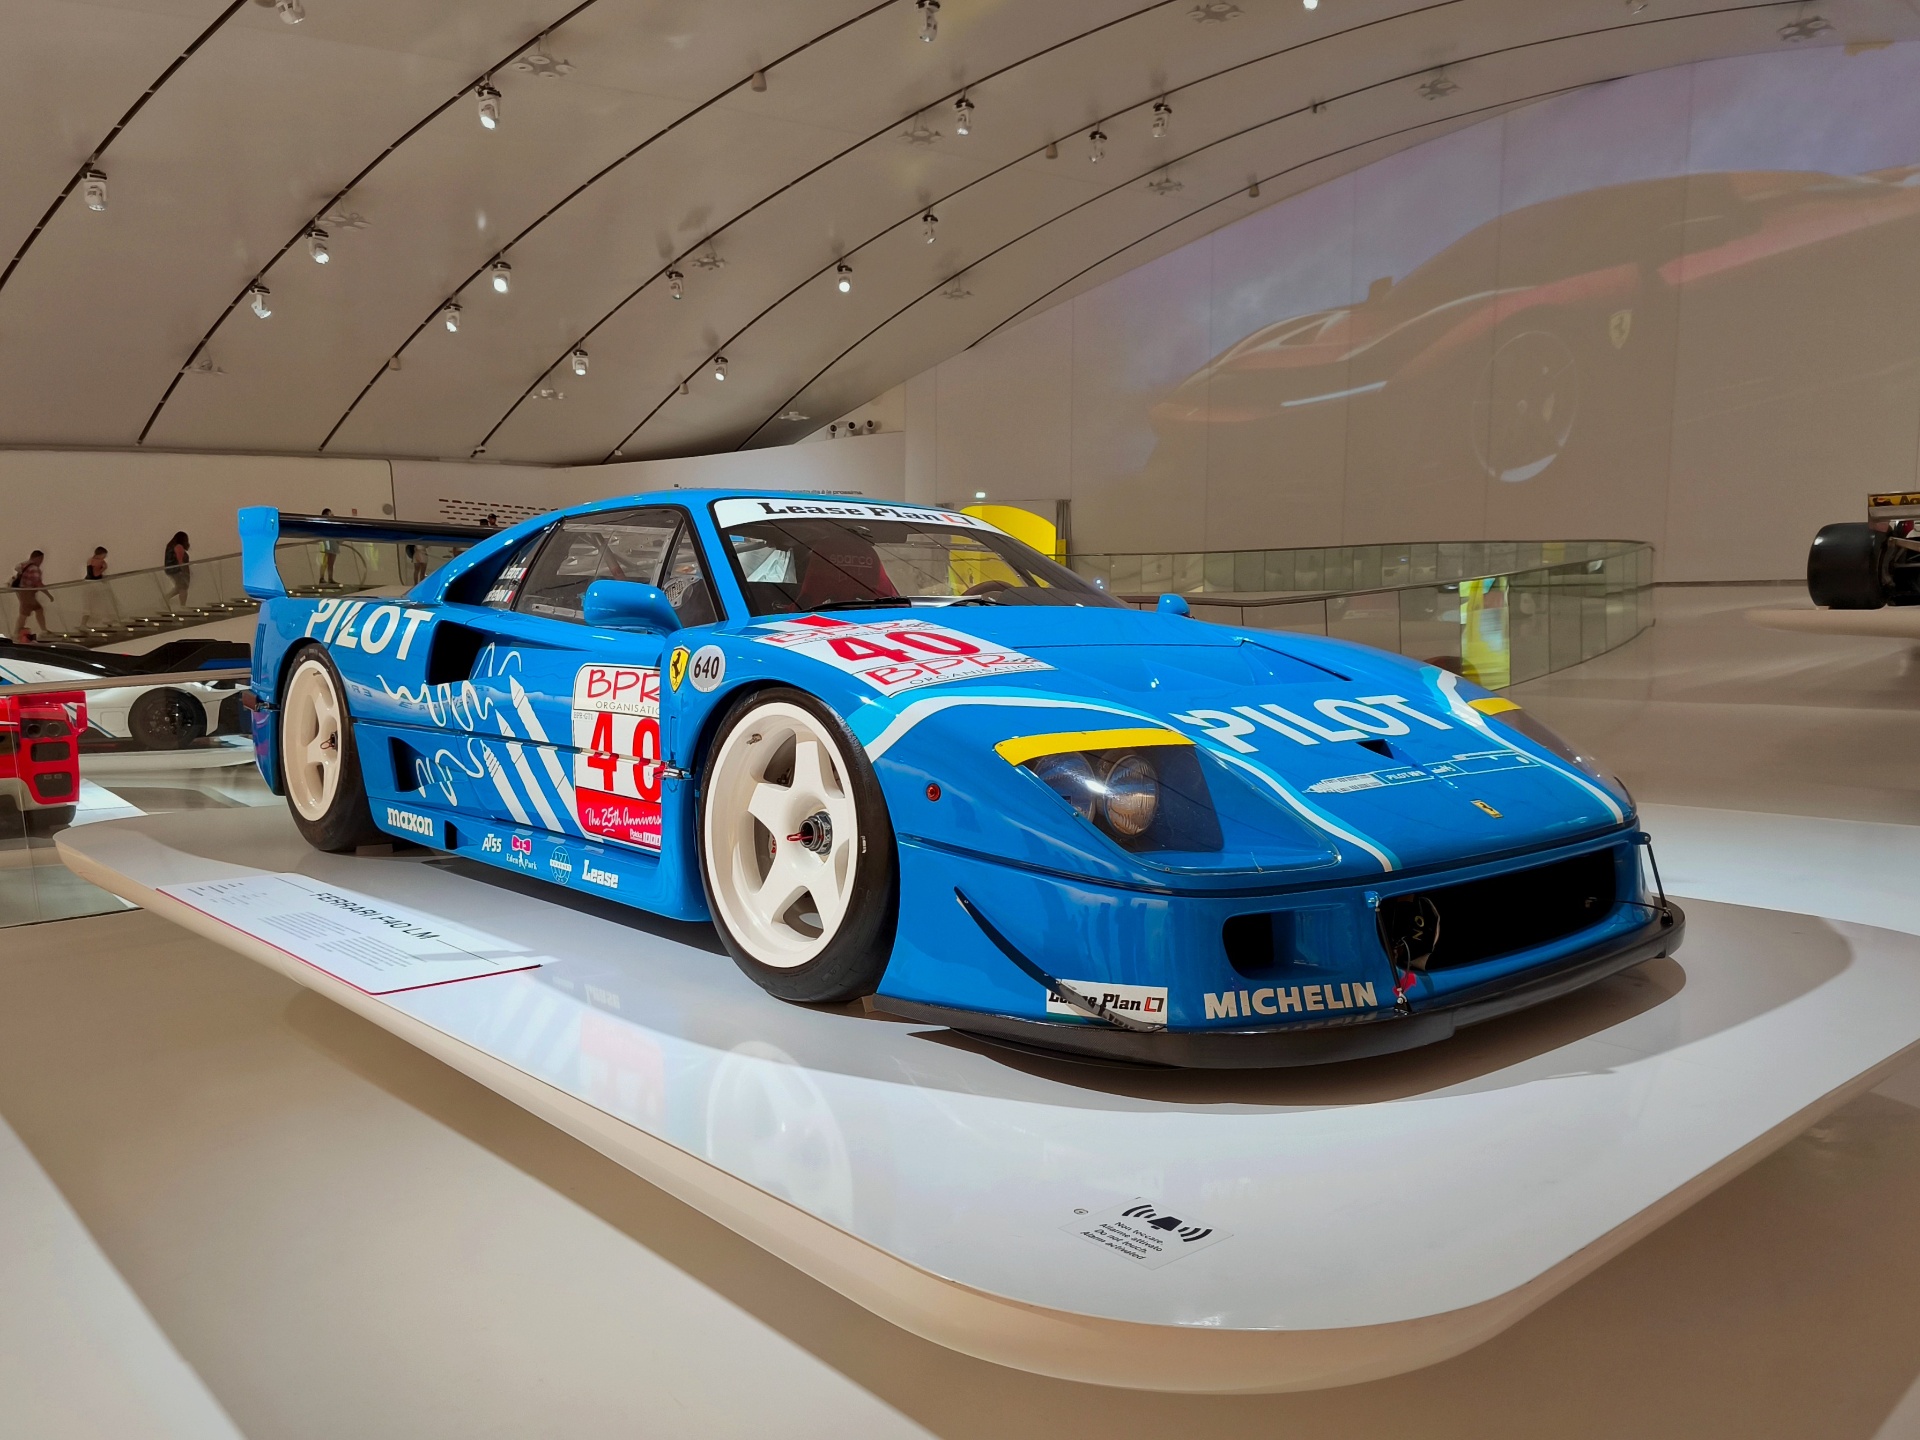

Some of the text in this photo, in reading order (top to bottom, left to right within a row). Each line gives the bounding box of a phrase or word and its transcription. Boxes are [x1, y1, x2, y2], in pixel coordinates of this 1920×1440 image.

[757, 501, 944, 522] Lease Plan
[829, 553, 874, 567] sparco
[304, 598, 436, 661] PILOT
[827, 631, 981, 662] 40
[693, 656, 720, 680] 640
[865, 654, 1032, 686] BPR
[910, 664, 1043, 686] ORGANISATION
[587, 669, 660, 703] BPR
[1168, 694, 1454, 754] PILOT
[587, 712, 661, 802] 40
[387, 807, 434, 837] maxon
[585, 807, 601, 826] The
[601, 806, 622, 827] 25th
[506, 853, 538, 871] Eden Park
[581, 859, 619, 889] Lease
[310, 892, 381, 917] FERRARI
[370, 915, 412, 929] F40
[402, 927, 440, 940] LM
[1102, 993, 1141, 1011] Plan
[1203, 981, 1378, 1020] MICHELIN
[1094, 1228, 1107, 1236] Do
[1108, 1233, 1124, 1243] not
[1099, 1223, 1163, 1252] Allarme attivato
[1114, 1221, 1132, 1231] Non
[1080, 1231, 1147, 1260] Alarm activated
